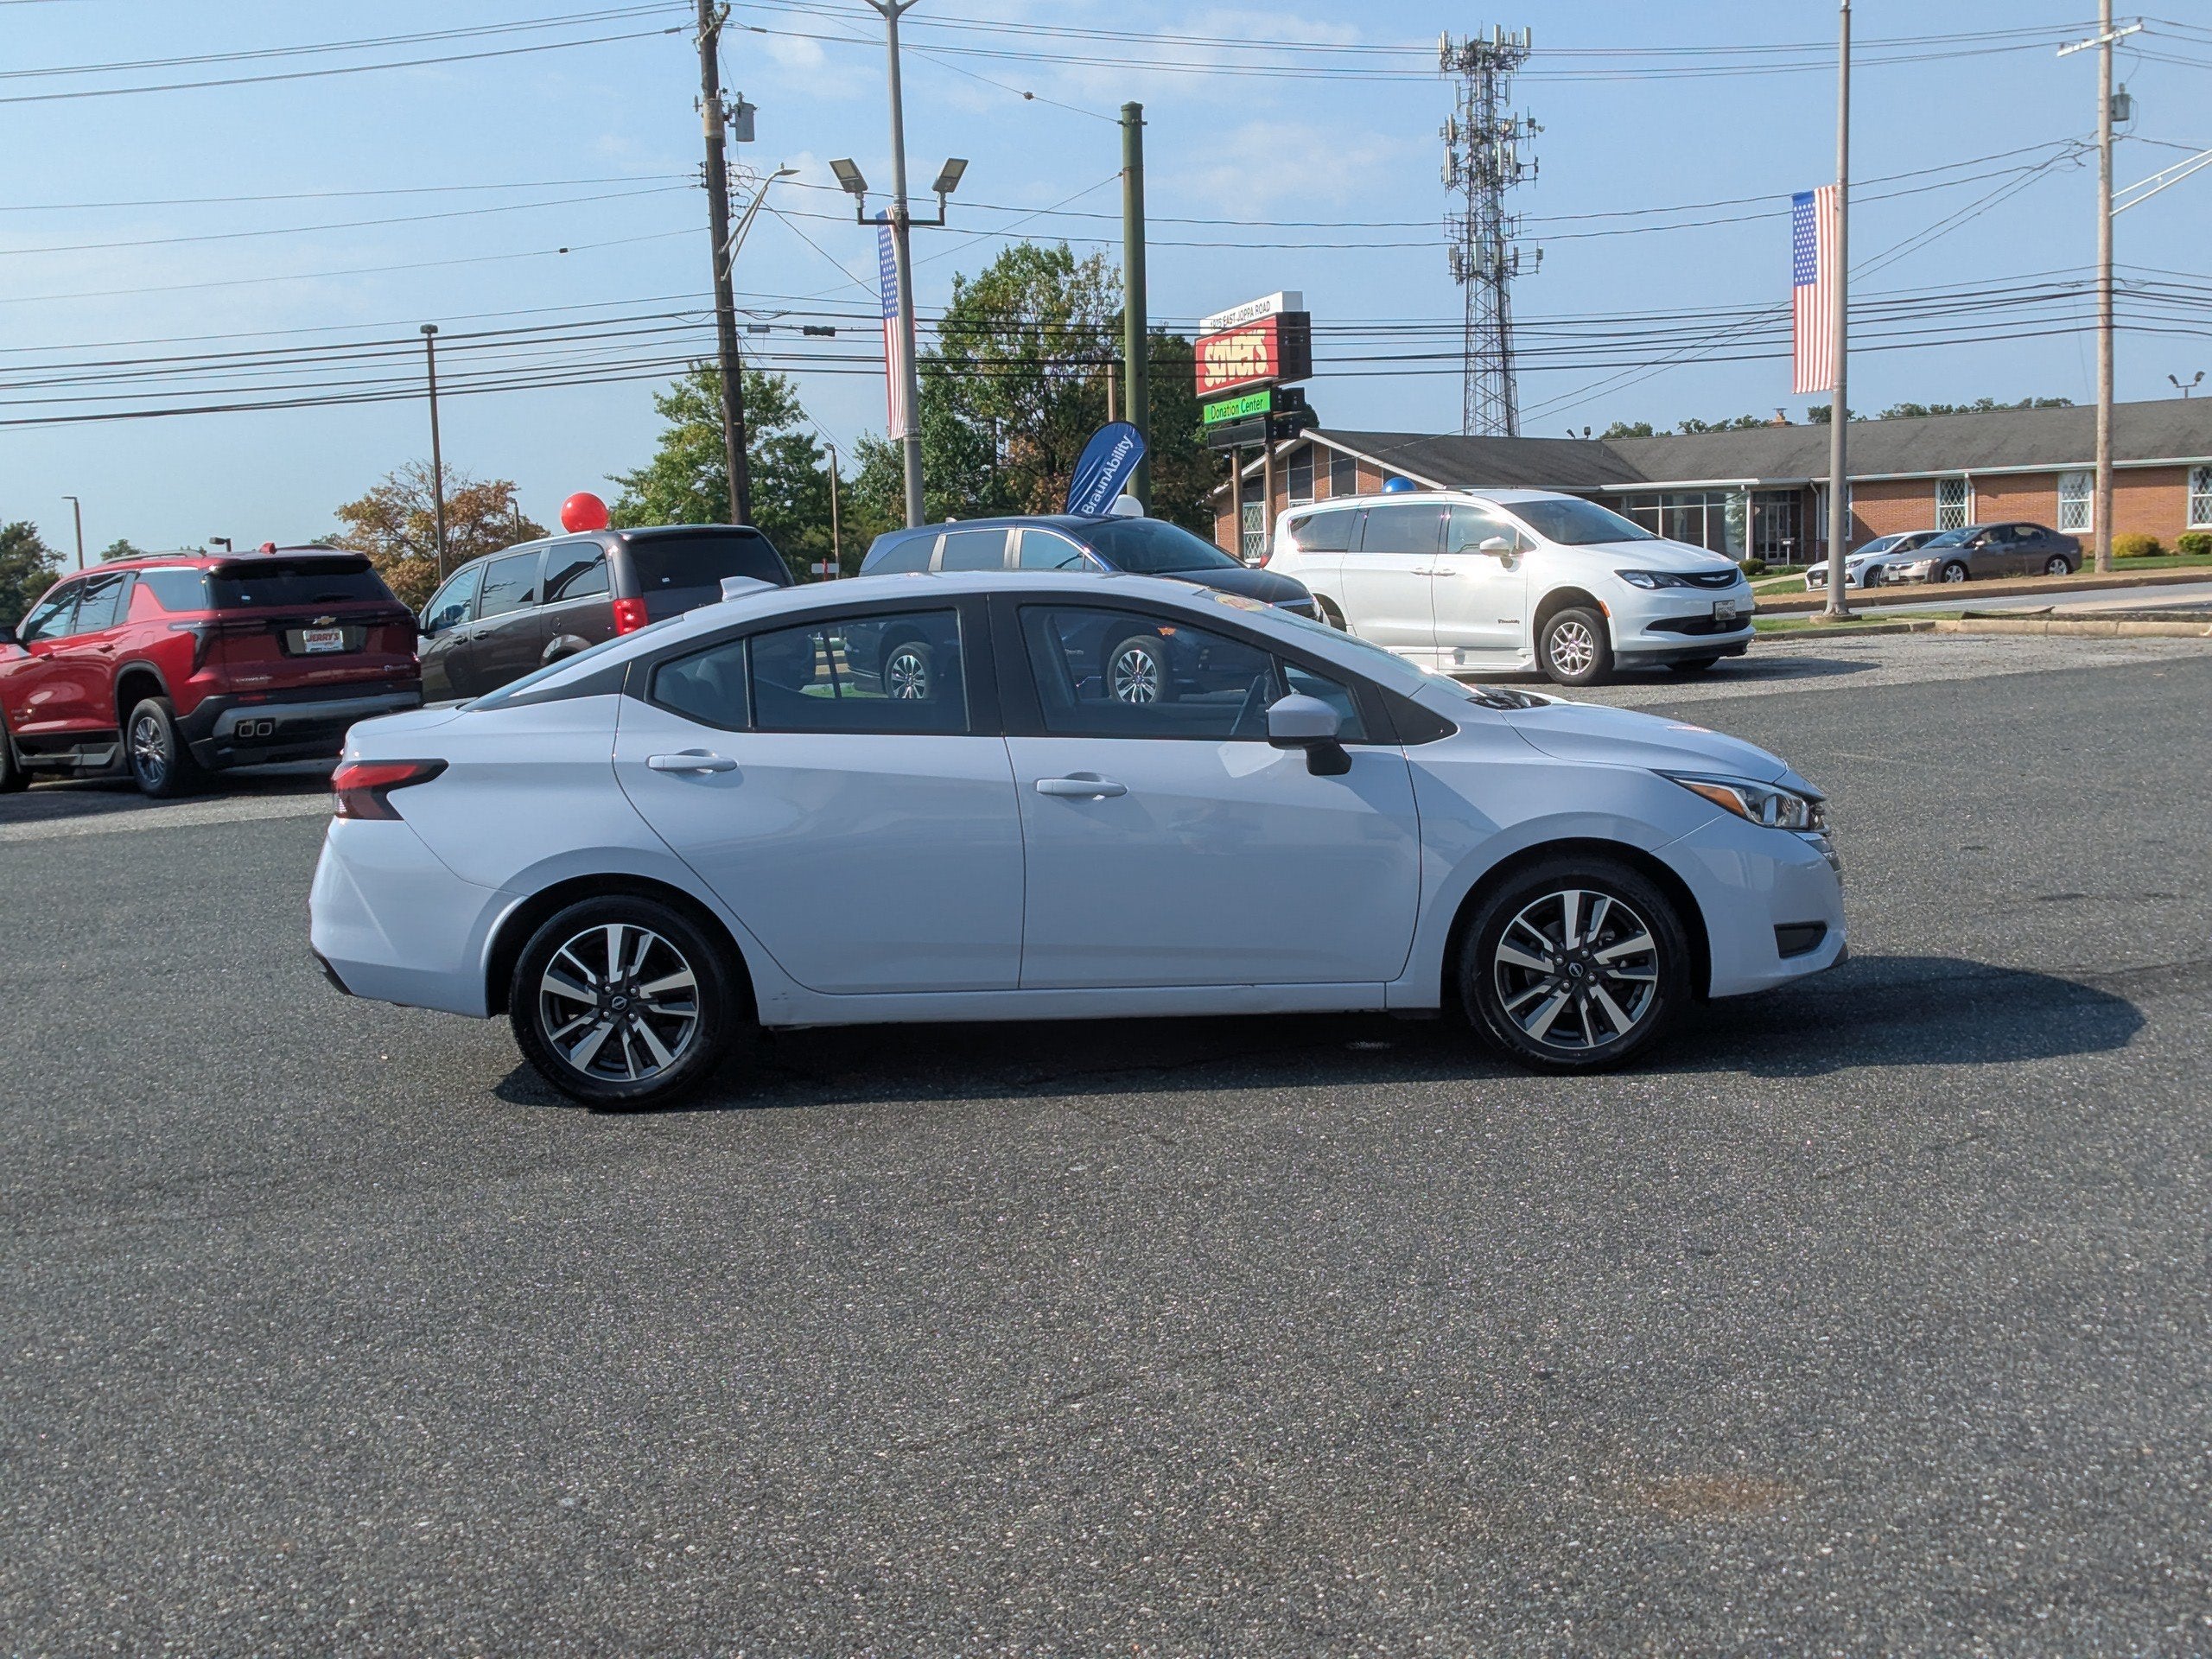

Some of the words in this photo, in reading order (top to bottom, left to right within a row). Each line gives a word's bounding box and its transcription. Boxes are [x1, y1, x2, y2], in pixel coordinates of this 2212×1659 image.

[1224, 312, 1236, 327] EAST
[1237, 307, 1254, 321] JOPPA
[1255, 300, 1271, 315] ROAD
[1211, 402, 1239, 420] Donation
[1240, 398, 1264, 414] Center
[1080, 433, 1134, 515] BraunAbility
[306, 632, 340, 643] JERRY'S
